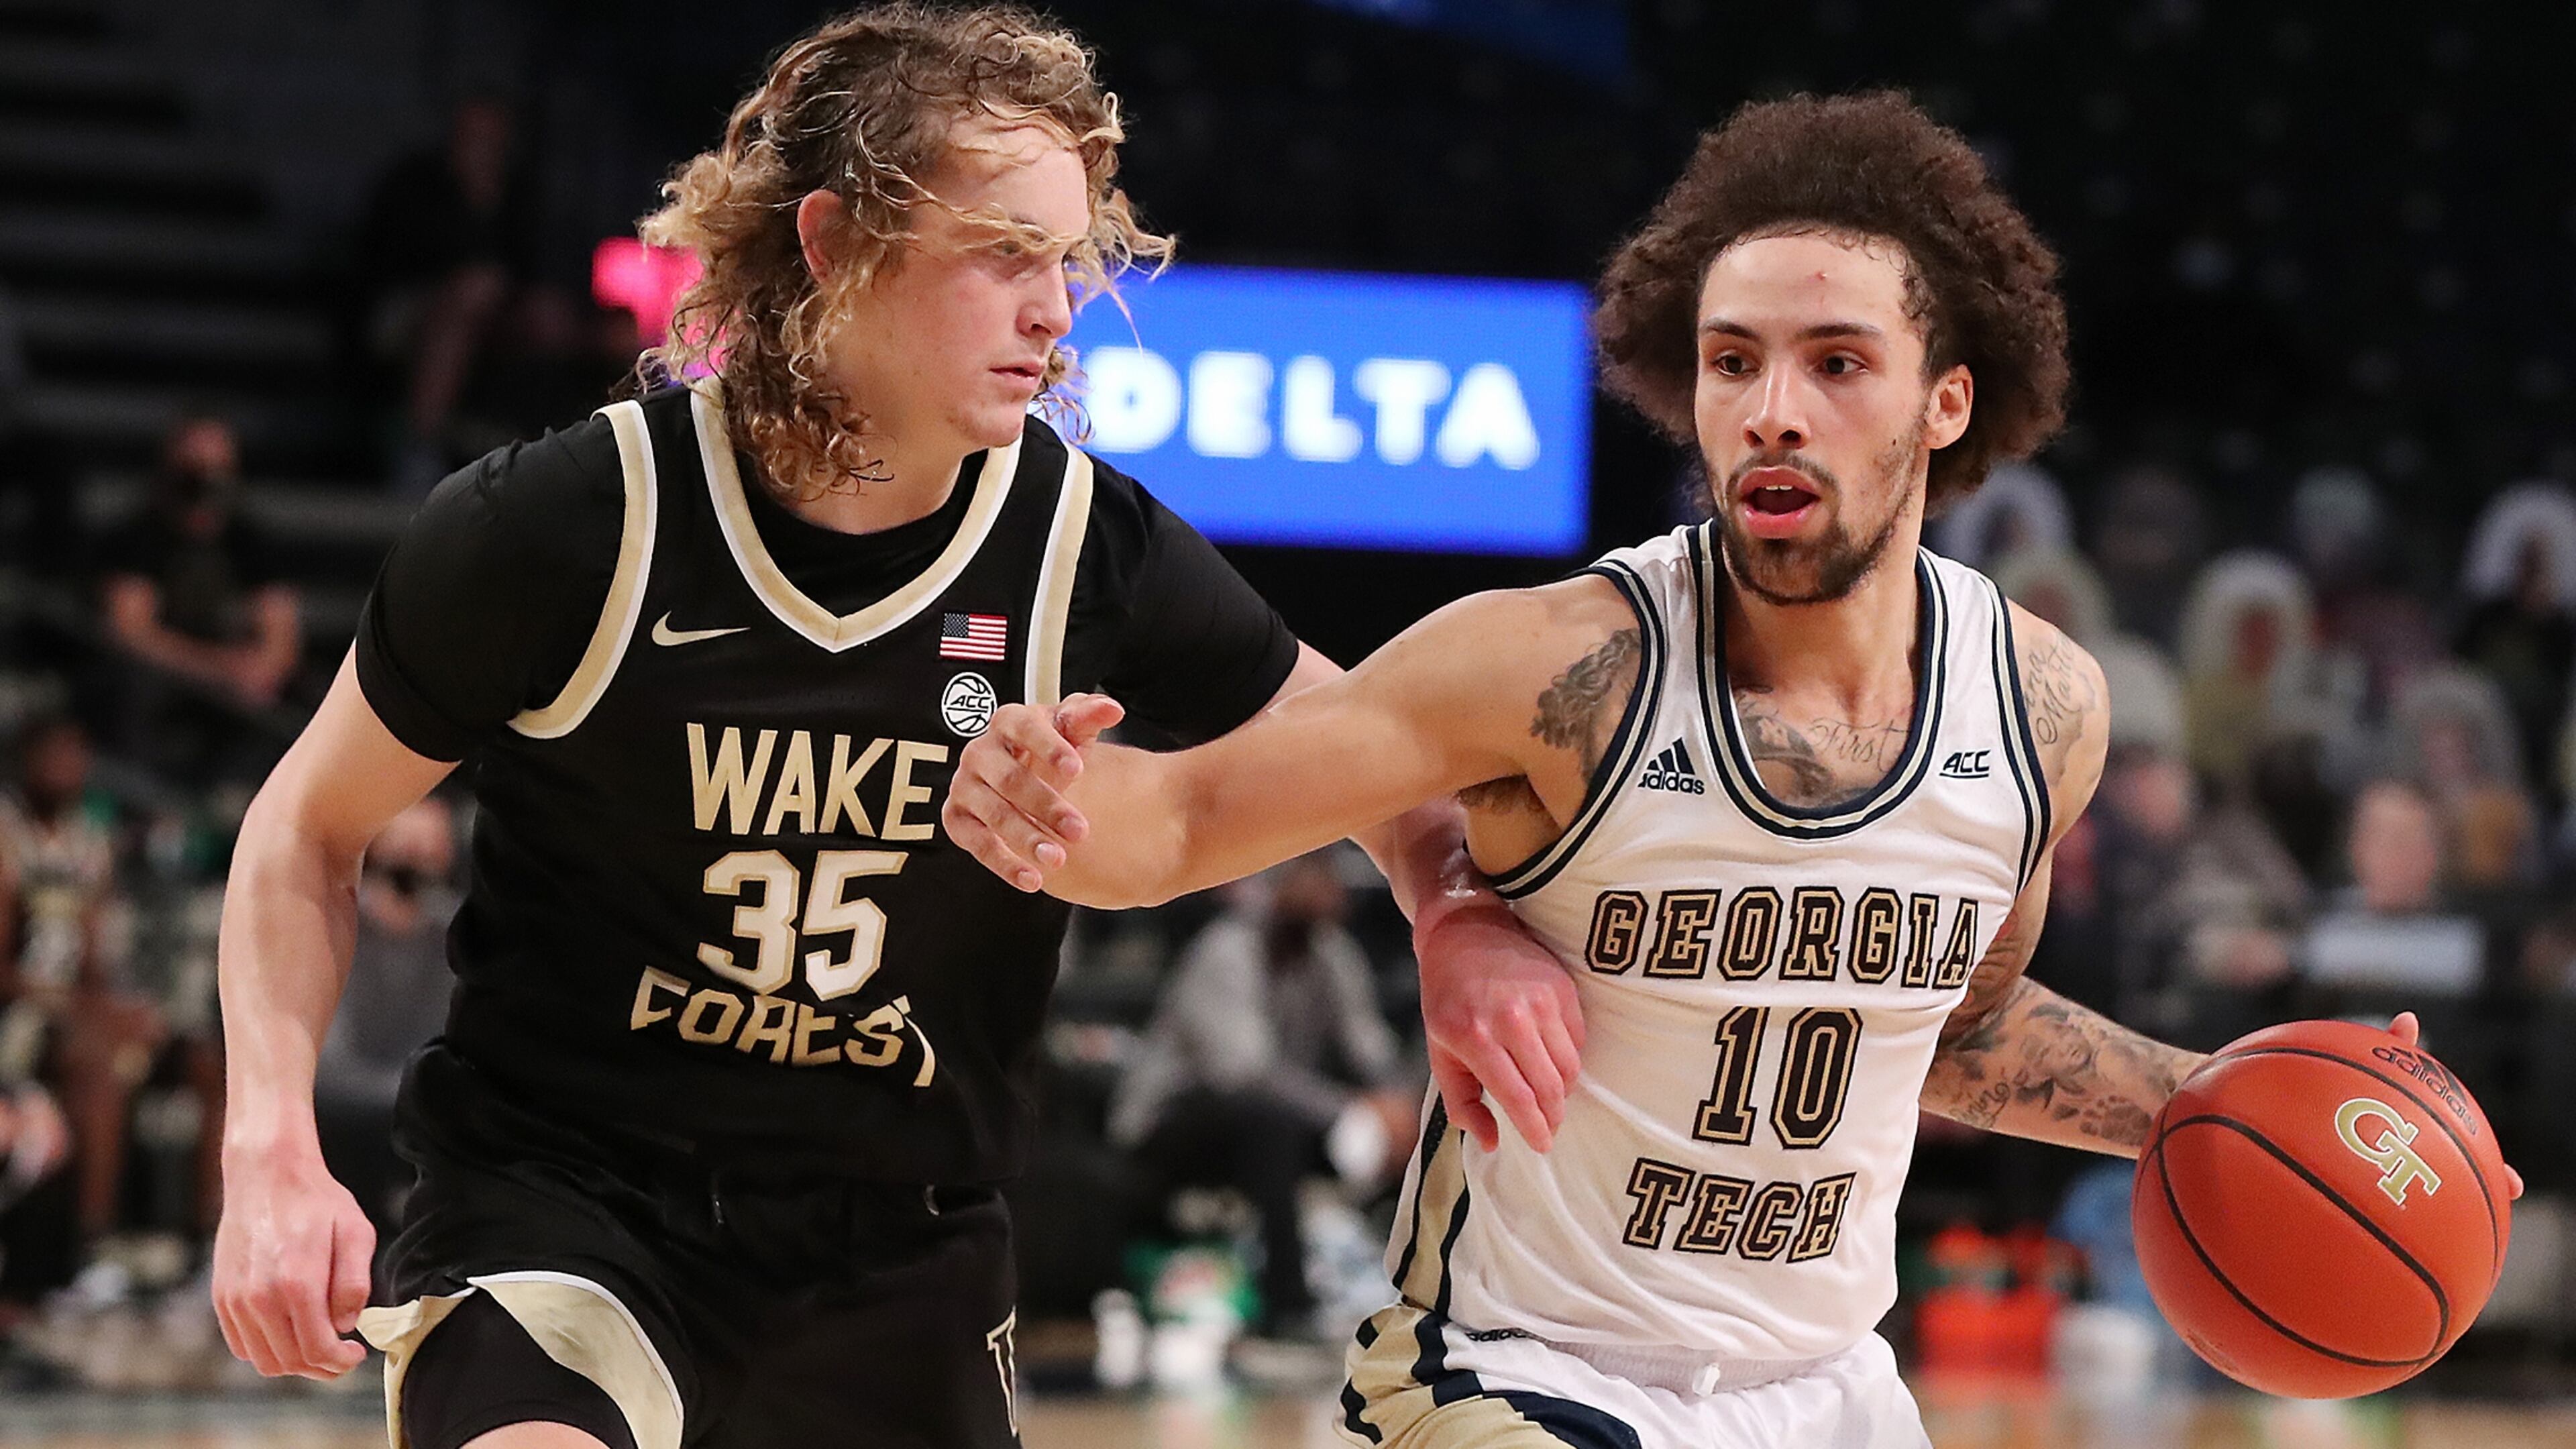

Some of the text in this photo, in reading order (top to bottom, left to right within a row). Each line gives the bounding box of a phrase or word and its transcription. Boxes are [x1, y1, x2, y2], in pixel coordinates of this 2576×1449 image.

[1081, 346, 1540, 470] DELTA
[951, 695, 991, 710] ACC
[686, 722, 949, 841] WAKE
[1943, 749, 1991, 773] ACC
[696, 849, 910, 1002] 35
[1585, 885, 1980, 989] GEORGIA
[1692, 1005, 1862, 1150] 10
[2372, 1045, 2477, 1136] adidas
[2334, 1097, 2442, 1206] GT
[1622, 1157, 1857, 1264] TECH
